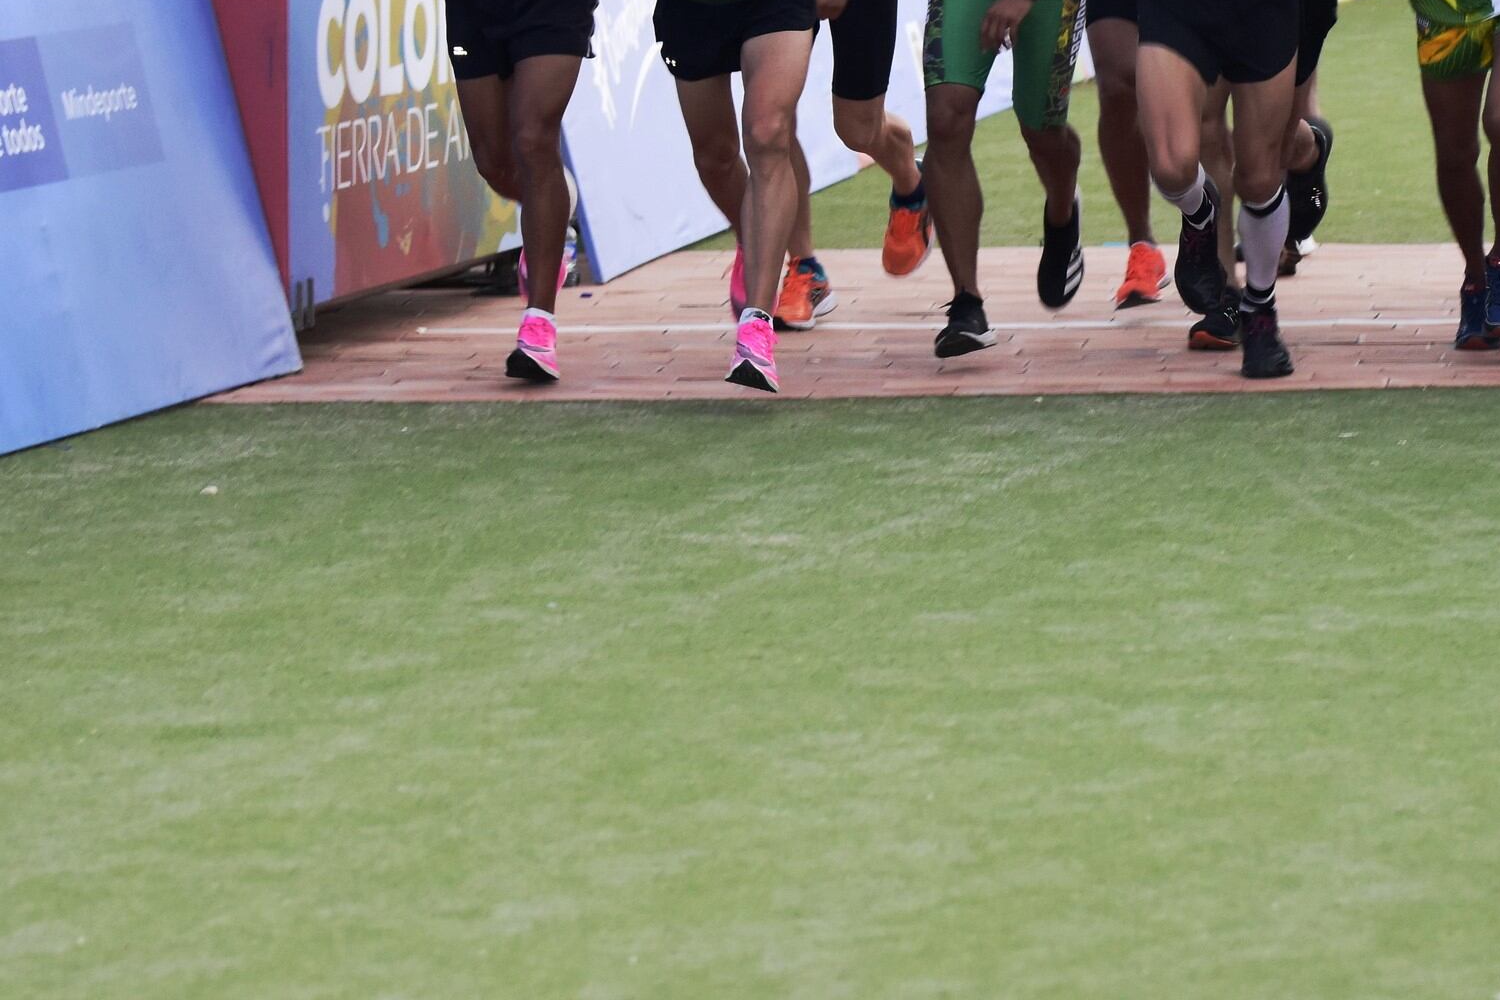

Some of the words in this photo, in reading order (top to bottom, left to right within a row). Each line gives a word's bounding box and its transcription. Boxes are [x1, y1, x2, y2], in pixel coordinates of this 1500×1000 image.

[61, 81, 138, 122] Mindeporte
[2, 117, 46, 156] todos
[316, 112, 401, 194] TIERRA
[406, 102, 440, 175] DE
